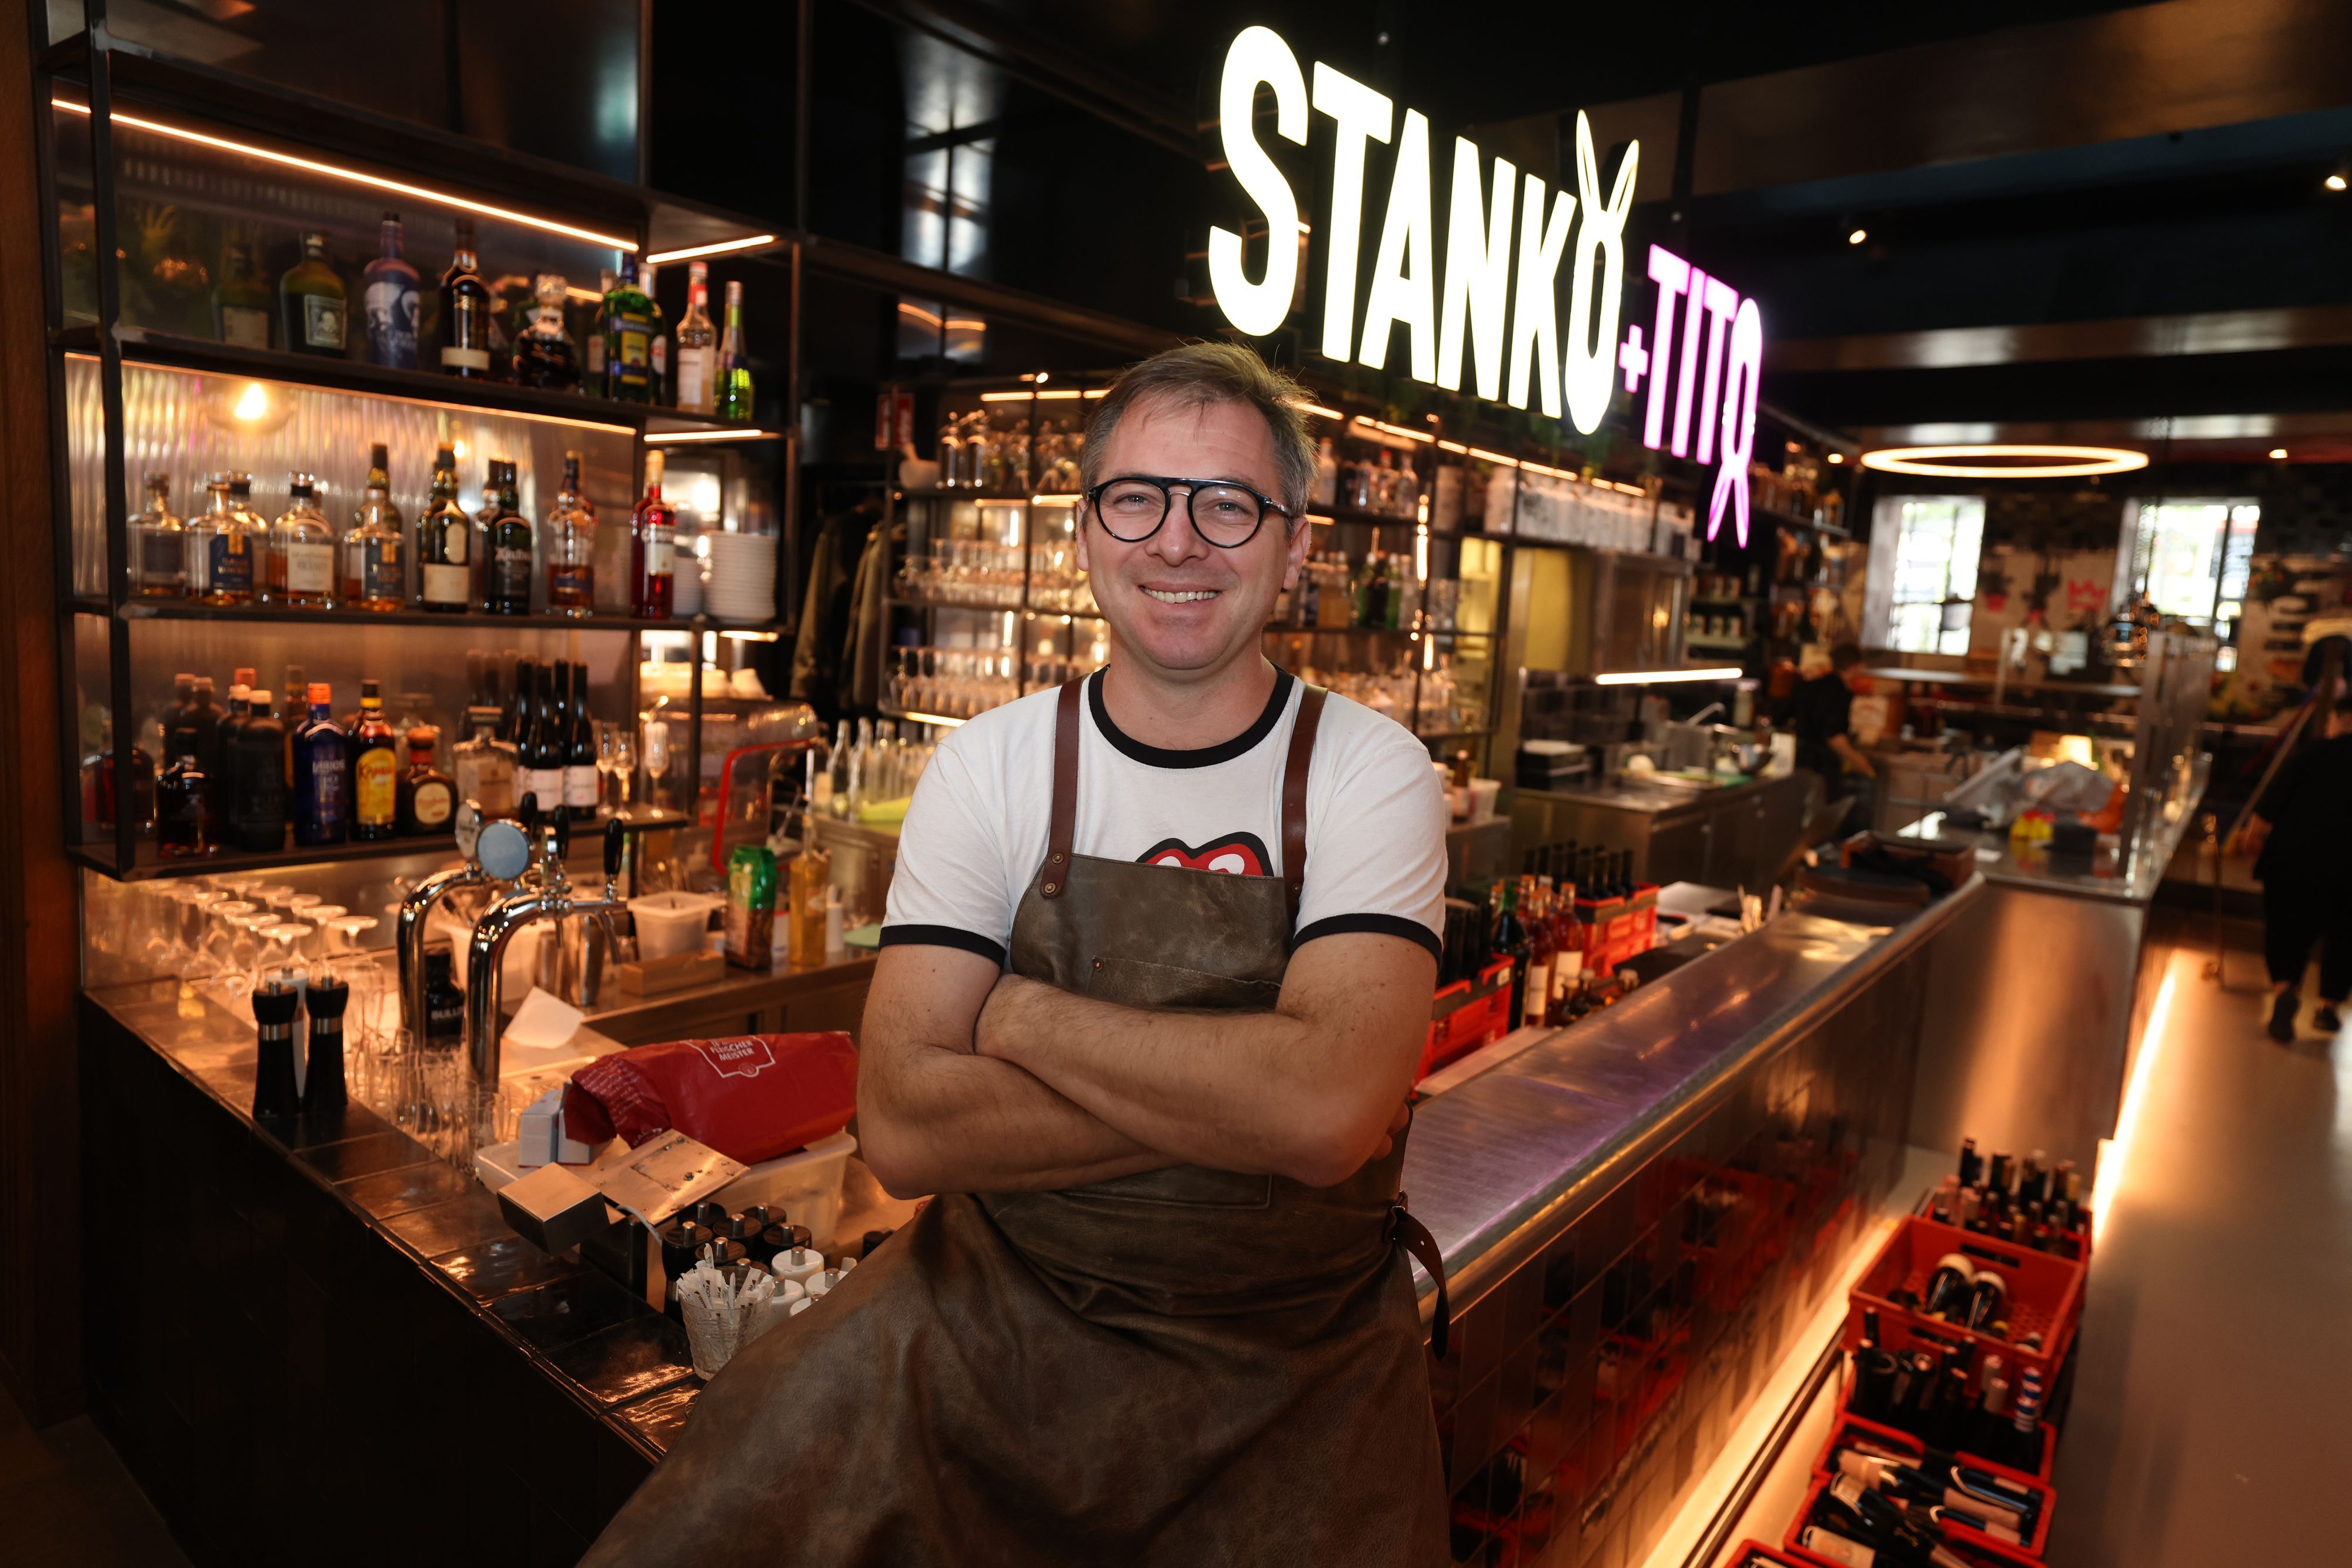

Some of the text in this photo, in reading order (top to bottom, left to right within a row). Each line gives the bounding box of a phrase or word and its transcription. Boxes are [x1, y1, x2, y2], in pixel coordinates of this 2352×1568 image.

[1208, 25, 1639, 434] STANKO
[1643, 243, 1763, 548] TITO
[710, 1040, 753, 1054] FLEISCHER
[719, 1047, 754, 1061] MEISTER
